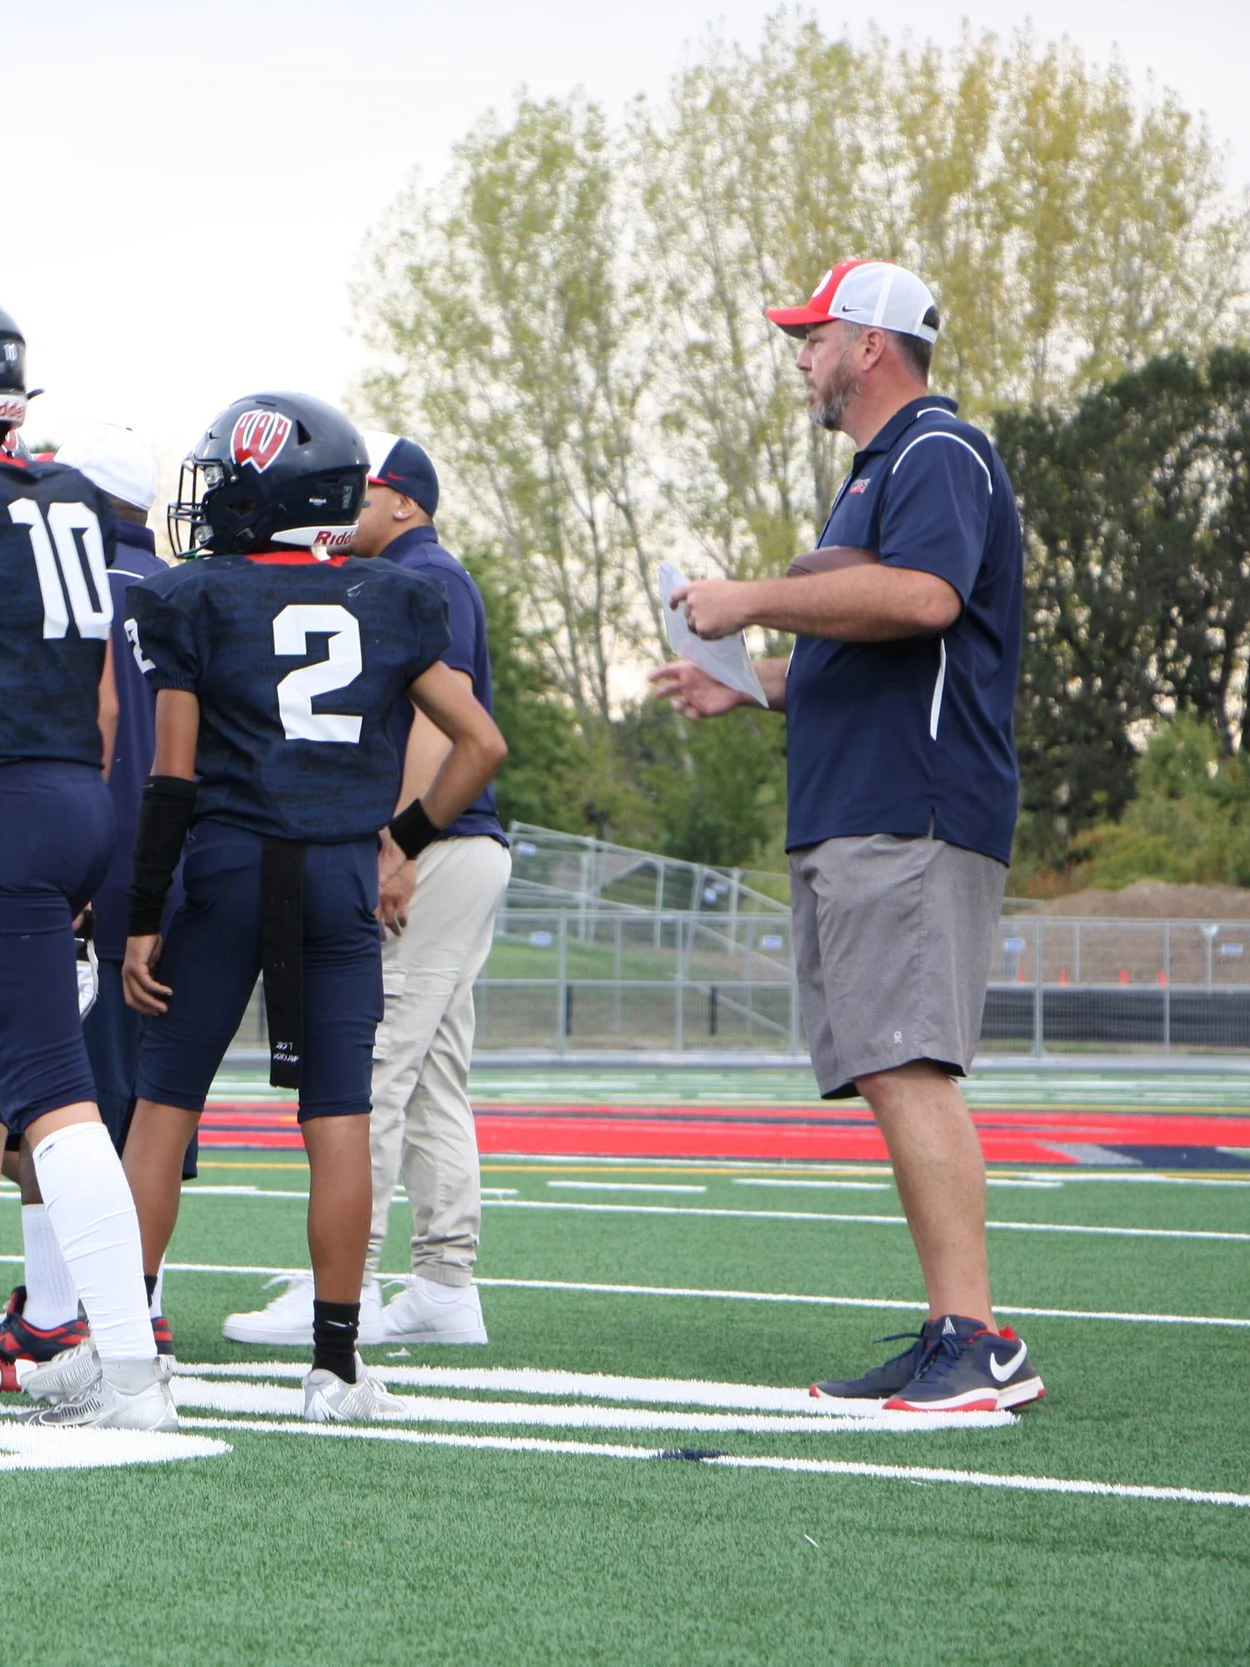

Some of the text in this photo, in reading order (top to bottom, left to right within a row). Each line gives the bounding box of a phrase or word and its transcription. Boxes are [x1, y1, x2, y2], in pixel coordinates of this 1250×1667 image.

[230, 409, 293, 473] W
[7, 497, 114, 640] 10
[314, 530, 355, 545] Ridd
[272, 604, 363, 744] 2
